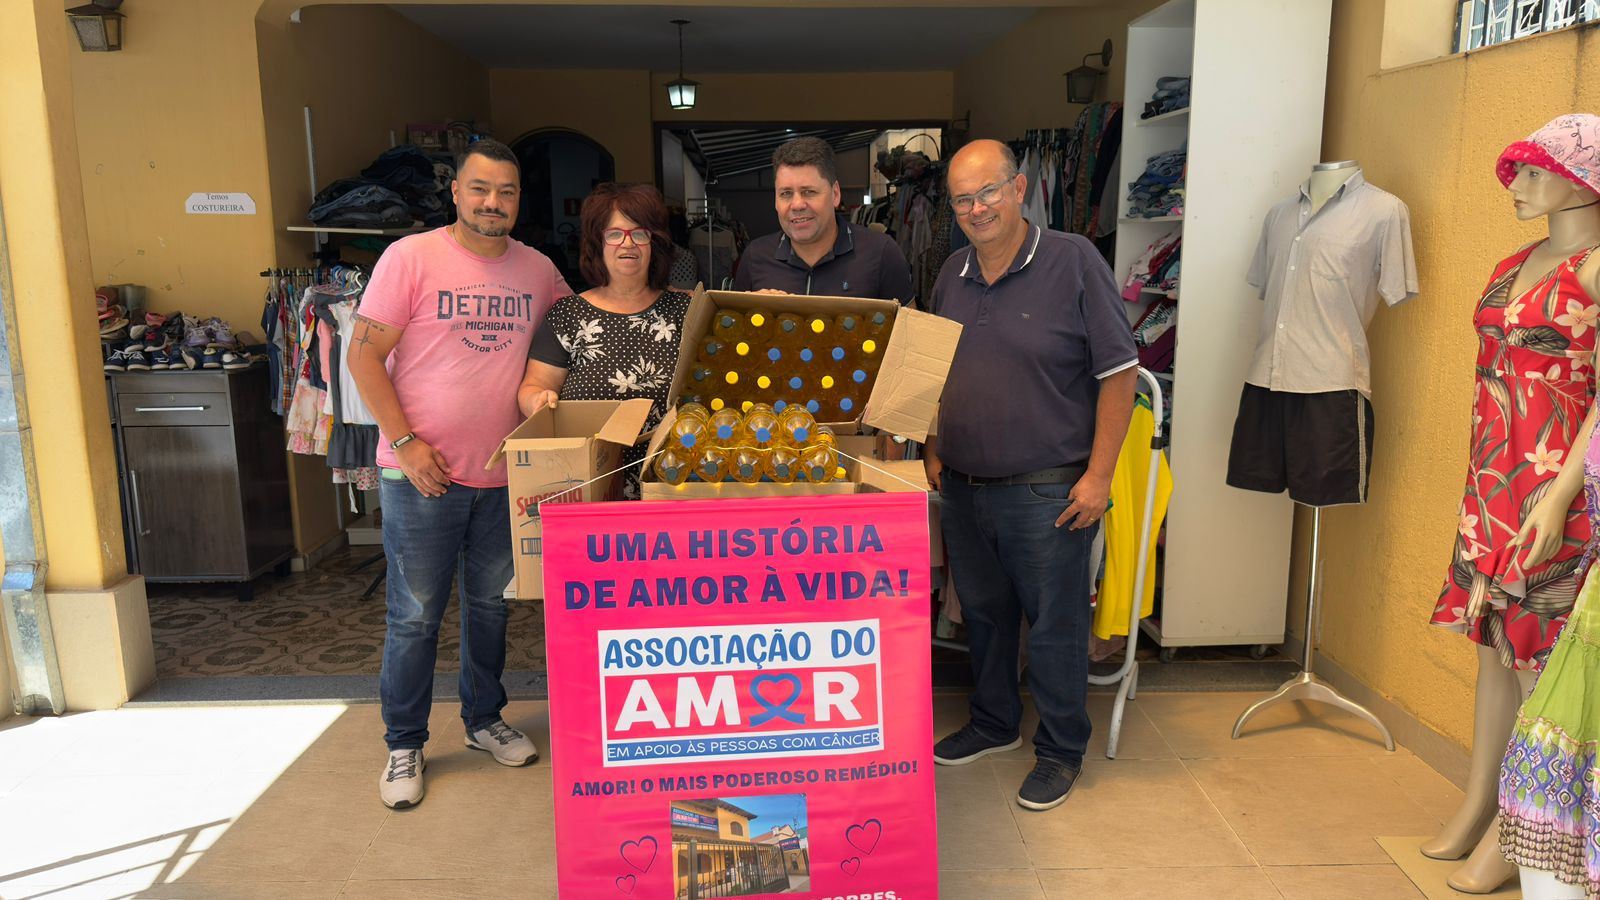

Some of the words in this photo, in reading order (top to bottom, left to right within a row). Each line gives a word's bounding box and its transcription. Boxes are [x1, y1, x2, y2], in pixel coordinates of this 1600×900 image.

[437, 290, 532, 321] DETROIT
[465, 321, 514, 331] MICHIGAN
[461, 337, 490, 352] MOTOR
[494, 338, 512, 351] CITY
[587, 531, 677, 562] UMA
[689, 518, 884, 559] HISTÓRIA
[565, 580, 617, 610] DE
[627, 575, 748, 607] AMOR
[760, 565, 787, 602] À
[795, 569, 909, 601] VIDA!
[604, 629, 811, 669] ASSOCIAÇÃO
[831, 627, 876, 659] DO
[608, 747, 630, 758] EM
[634, 744, 681, 757] APOIO
[686, 741, 706, 754] ÀS
[710, 739, 778, 753] PESSOAS
[782, 736, 817, 749] COM
[821, 733, 880, 747] CÂNCER
[572, 780, 636, 796] AMOR!
[641, 779, 654, 793] O
[659, 776, 708, 792] MAIS
[713, 769, 819, 789] PODEROSO
[824, 760, 918, 782] REMÉDIO!
[822, 891, 902, 900] RRES,
